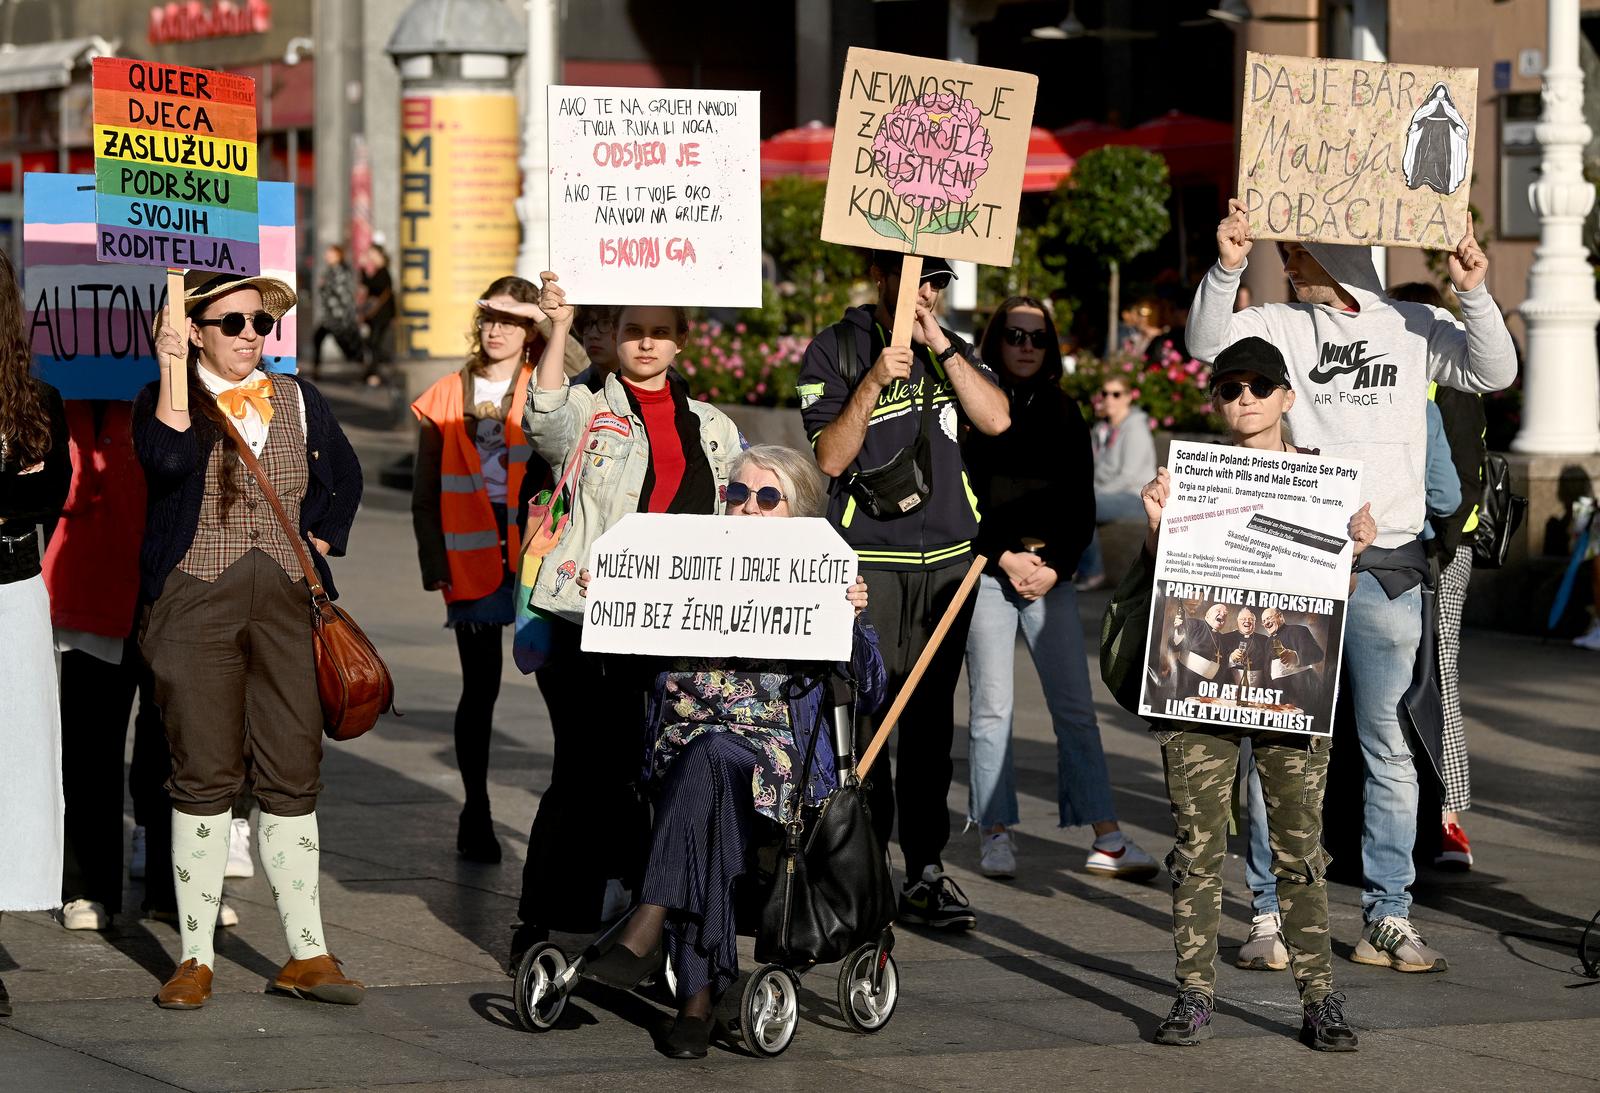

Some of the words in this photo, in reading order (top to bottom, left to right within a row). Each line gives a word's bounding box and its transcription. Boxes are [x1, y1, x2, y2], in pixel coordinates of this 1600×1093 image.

[129, 64, 212, 100] QUEER
[850, 69, 974, 113] NEVINOST
[980, 87, 1014, 121] JE
[1352, 69, 1416, 109] BAR
[129, 98, 214, 132] DJECA
[559, 97, 586, 116] AKO
[594, 98, 613, 114] TE
[620, 98, 644, 115] NA
[648, 99, 692, 116] GRIJEH
[698, 100, 738, 116] NAVODI
[580, 120, 616, 136] TVOJA
[623, 119, 660, 136] RUKA
[664, 121, 674, 135] ILI
[857, 111, 989, 158] ZASTARJELI
[103, 130, 248, 171] ZASLUŽUJU
[675, 142, 702, 168] JE
[1248, 115, 1396, 205] Marija
[855, 147, 975, 190] DRUŠTVENI
[122, 167, 230, 204] PODRŠKU
[564, 184, 590, 203] AKO
[597, 185, 618, 201] TE
[634, 185, 677, 204] TVOJE
[685, 184, 710, 200] OKO
[128, 202, 208, 234] SVOJIH
[594, 205, 645, 226] NAVODI
[650, 206, 668, 224] NA
[848, 185, 1002, 240] KONSTRUKT.
[1246, 188, 1453, 246] POBACILA
[600, 236, 660, 269] ISKOPAJ
[665, 237, 696, 266] GA
[1320, 340, 1368, 368] NIKE
[1352, 364, 1398, 390] AIR
[1314, 394, 1332, 405] AIR
[1340, 392, 1378, 406] FORCE
[1174, 462, 1182, 474] in
[1184, 464, 1214, 478] Church
[1215, 468, 1234, 479] with
[1235, 469, 1252, 481] Pills
[1254, 472, 1270, 483] and
[1272, 474, 1290, 486] Male
[1292, 476, 1318, 488] Escort
[1176, 449, 1208, 462] Scandal
[1210, 452, 1218, 463] in
[1219, 454, 1250, 466] Poland:
[1252, 456, 1280, 470] Priests
[1281, 462, 1318, 474] Organize
[1319, 464, 1334, 476] Sex
[1336, 466, 1358, 480] Party
[1179, 481, 1196, 492] Orgia
[1197, 484, 1206, 492] na
[1206, 484, 1234, 494] plebanii.
[1235, 487, 1276, 499] Dramatyczna
[1277, 492, 1308, 502] rozmowa.
[1322, 498, 1344, 508] umrze,
[1198, 495, 1206, 503] 27
[1227, 530, 1250, 542] Skandal
[1250, 538, 1270, 549] potresa
[1271, 544, 1291, 556] poljsku
[596, 548, 660, 580] MUŽEVNI
[668, 556, 722, 581] BUDITE
[730, 558, 734, 581] I
[740, 556, 780, 583] DALJE
[788, 554, 850, 584] KLEČITE
[590, 600, 636, 628] ONDA
[641, 602, 674, 629] BEZ
[1165, 582, 1212, 602] PARTY
[1214, 587, 1244, 605] LIKE
[1246, 590, 1256, 606] A
[1258, 592, 1334, 616] ROCKSTAR
[1198, 681, 1218, 698] OR
[1220, 684, 1239, 700] AT
[1241, 686, 1284, 705] LEAST
[1165, 699, 1196, 718] LIKE
[1197, 702, 1208, 718] A
[1264, 712, 1314, 731] PRIEST
